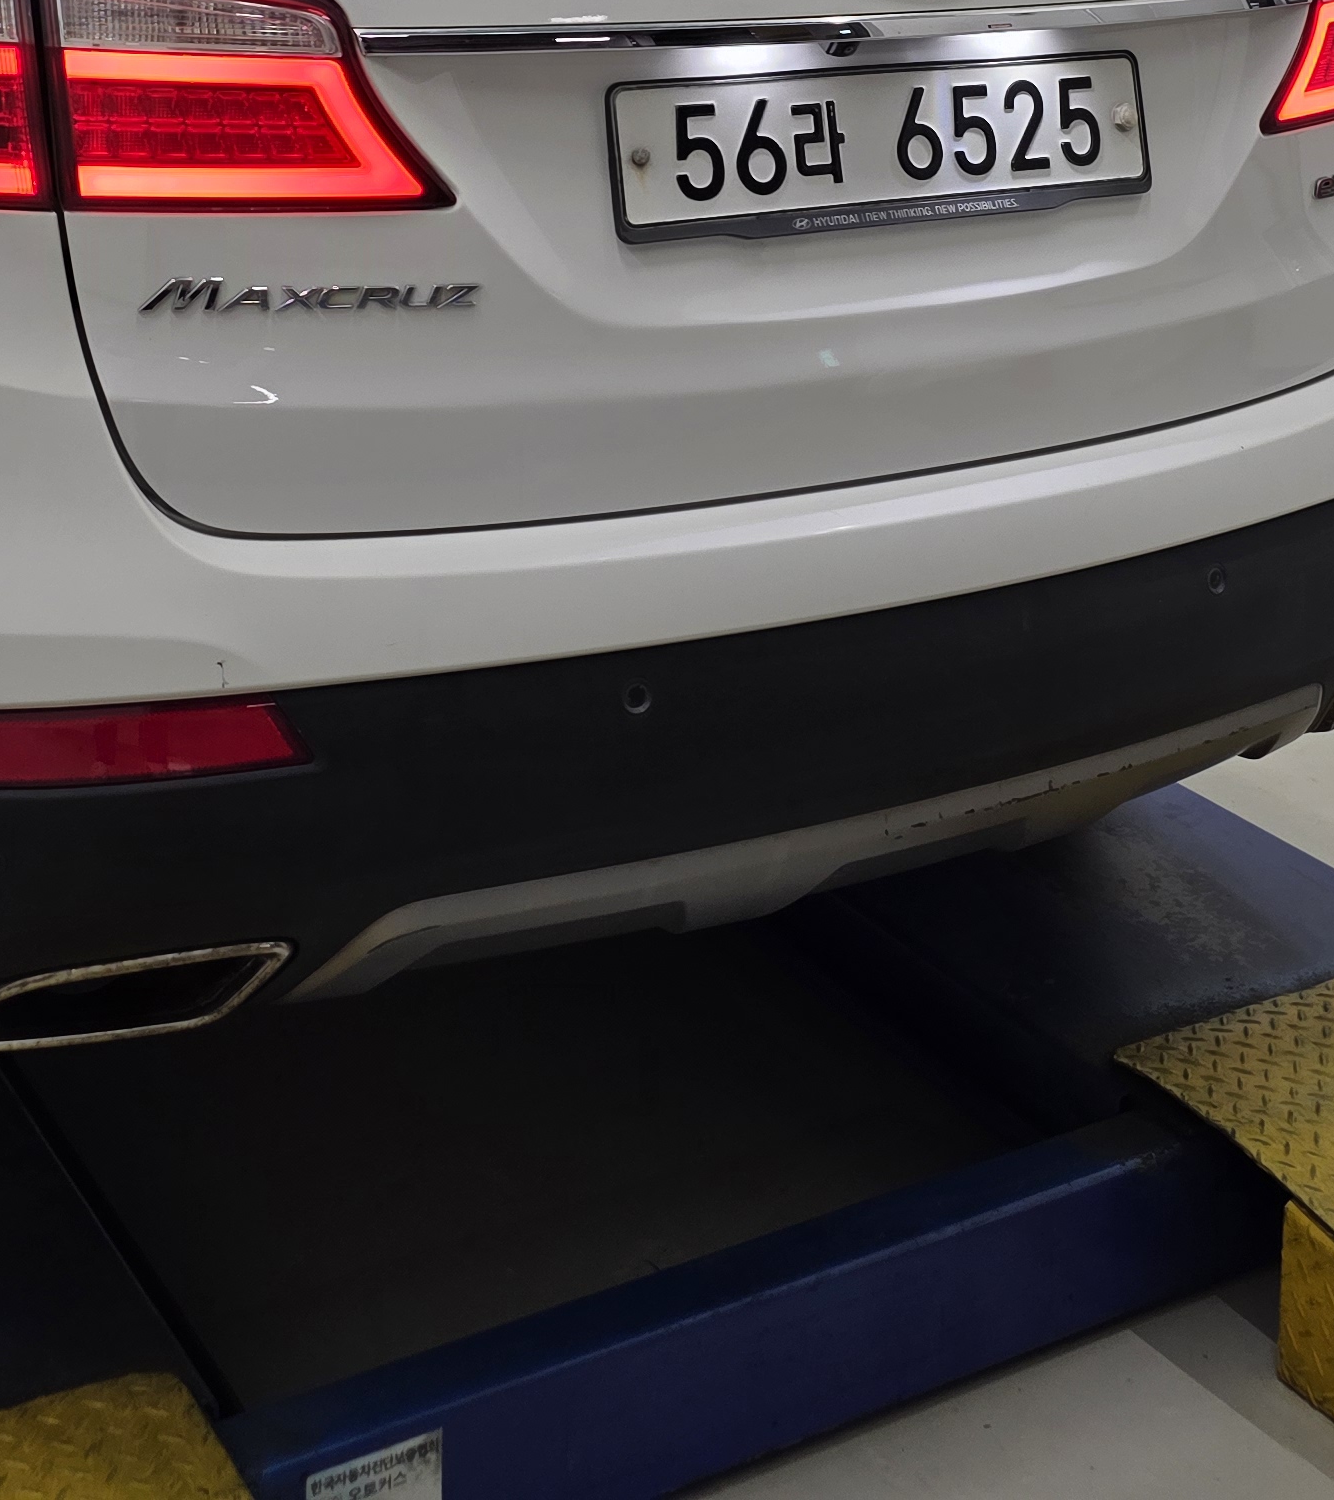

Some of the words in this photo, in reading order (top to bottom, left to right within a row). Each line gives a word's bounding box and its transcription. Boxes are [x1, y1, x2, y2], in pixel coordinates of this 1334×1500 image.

[675, 98, 846, 202] 56라
[896, 75, 1102, 181] 6525
[814, 213, 860, 227] HYUNDAI
[137, 276, 480, 312] MAXCRUZ
